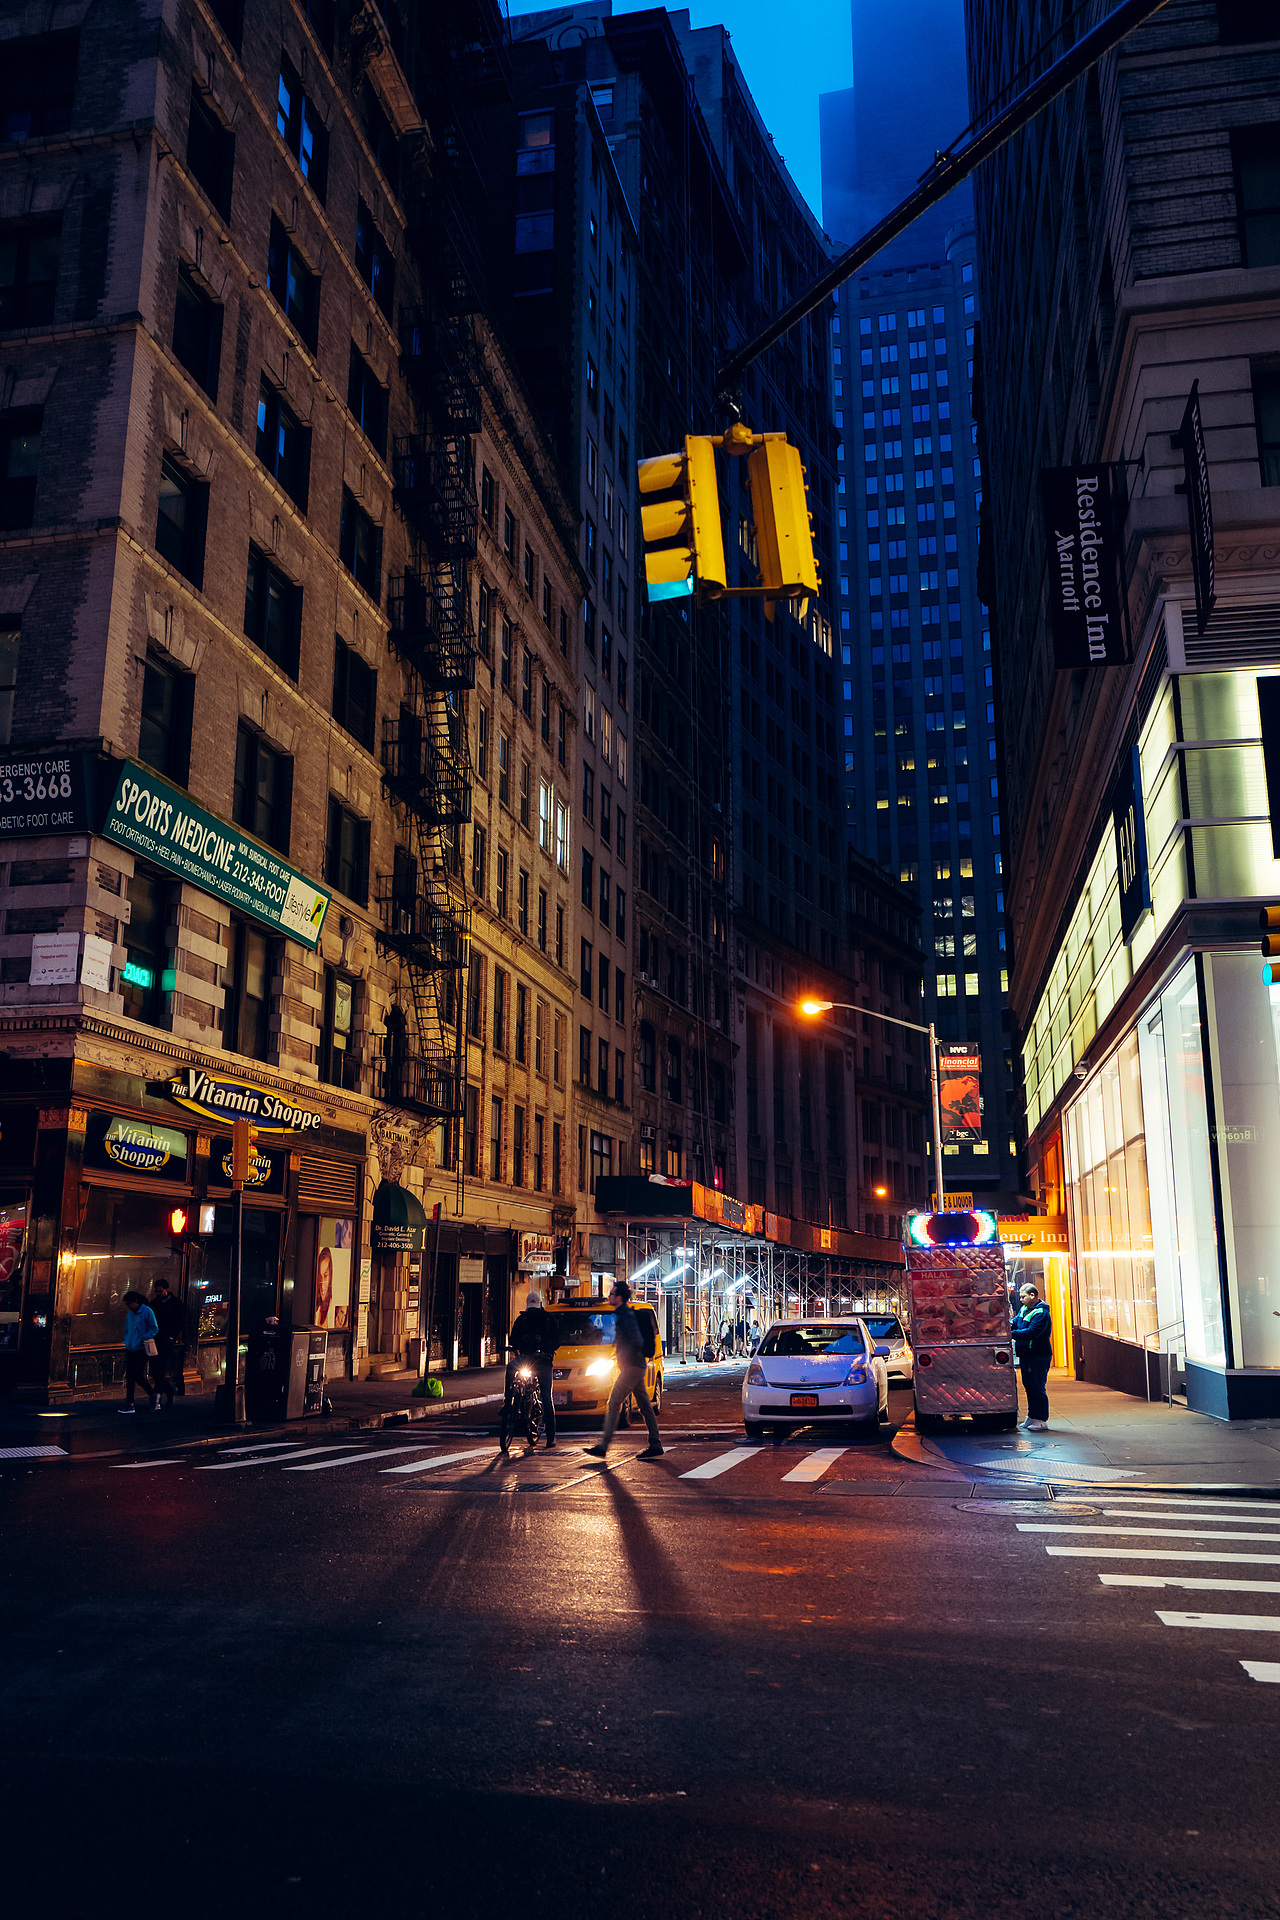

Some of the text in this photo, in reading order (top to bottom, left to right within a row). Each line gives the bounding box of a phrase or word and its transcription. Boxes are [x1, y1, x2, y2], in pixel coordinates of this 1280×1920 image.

[1054, 530, 1080, 612] Marriott
[1076, 476, 1109, 661] Residence Inn
[0, 760, 71, 778] ERGENCY CARE
[26, 813, 49, 827] FOOT
[51, 812, 74, 825] CARE
[116, 778, 236, 873] SPORTS MEDICINE
[109, 818, 127, 836] FOOT
[126, 826, 156, 852] ORTHOTICS
[157, 844, 171, 861] HEEL
[169, 851, 183, 866] PAIN
[183, 859, 217, 886] BIOMECHANICS
[217, 878, 233, 895] LASER
[231, 885, 252, 903] PODIATRY
[1119, 804, 1136, 894] GAP
[238, 841, 291, 884] NON SURGICAL FOOT CARE
[232, 860, 286, 905] 212-343-FOOT
[284, 891, 312, 922] Lifestyle
[949, 1046, 968, 1054] NYC
[940, 1057, 978, 1067] financial
[171, 1069, 321, 1131] THE Vitamin Shoppe
[106, 1124, 170, 1151] THE Vitamin
[956, 1130, 969, 1138] bgc
[109, 1144, 163, 1167] Shoppe
[948, 1196, 952, 1208] &
[952, 1195, 973, 1208] LIQUOR
[997, 1212, 1030, 1222] arriott
[420, 1227, 427, 1250] 1
[1039, 1230, 1068, 1243] Inn
[921, 1271, 951, 1280] HALAL
